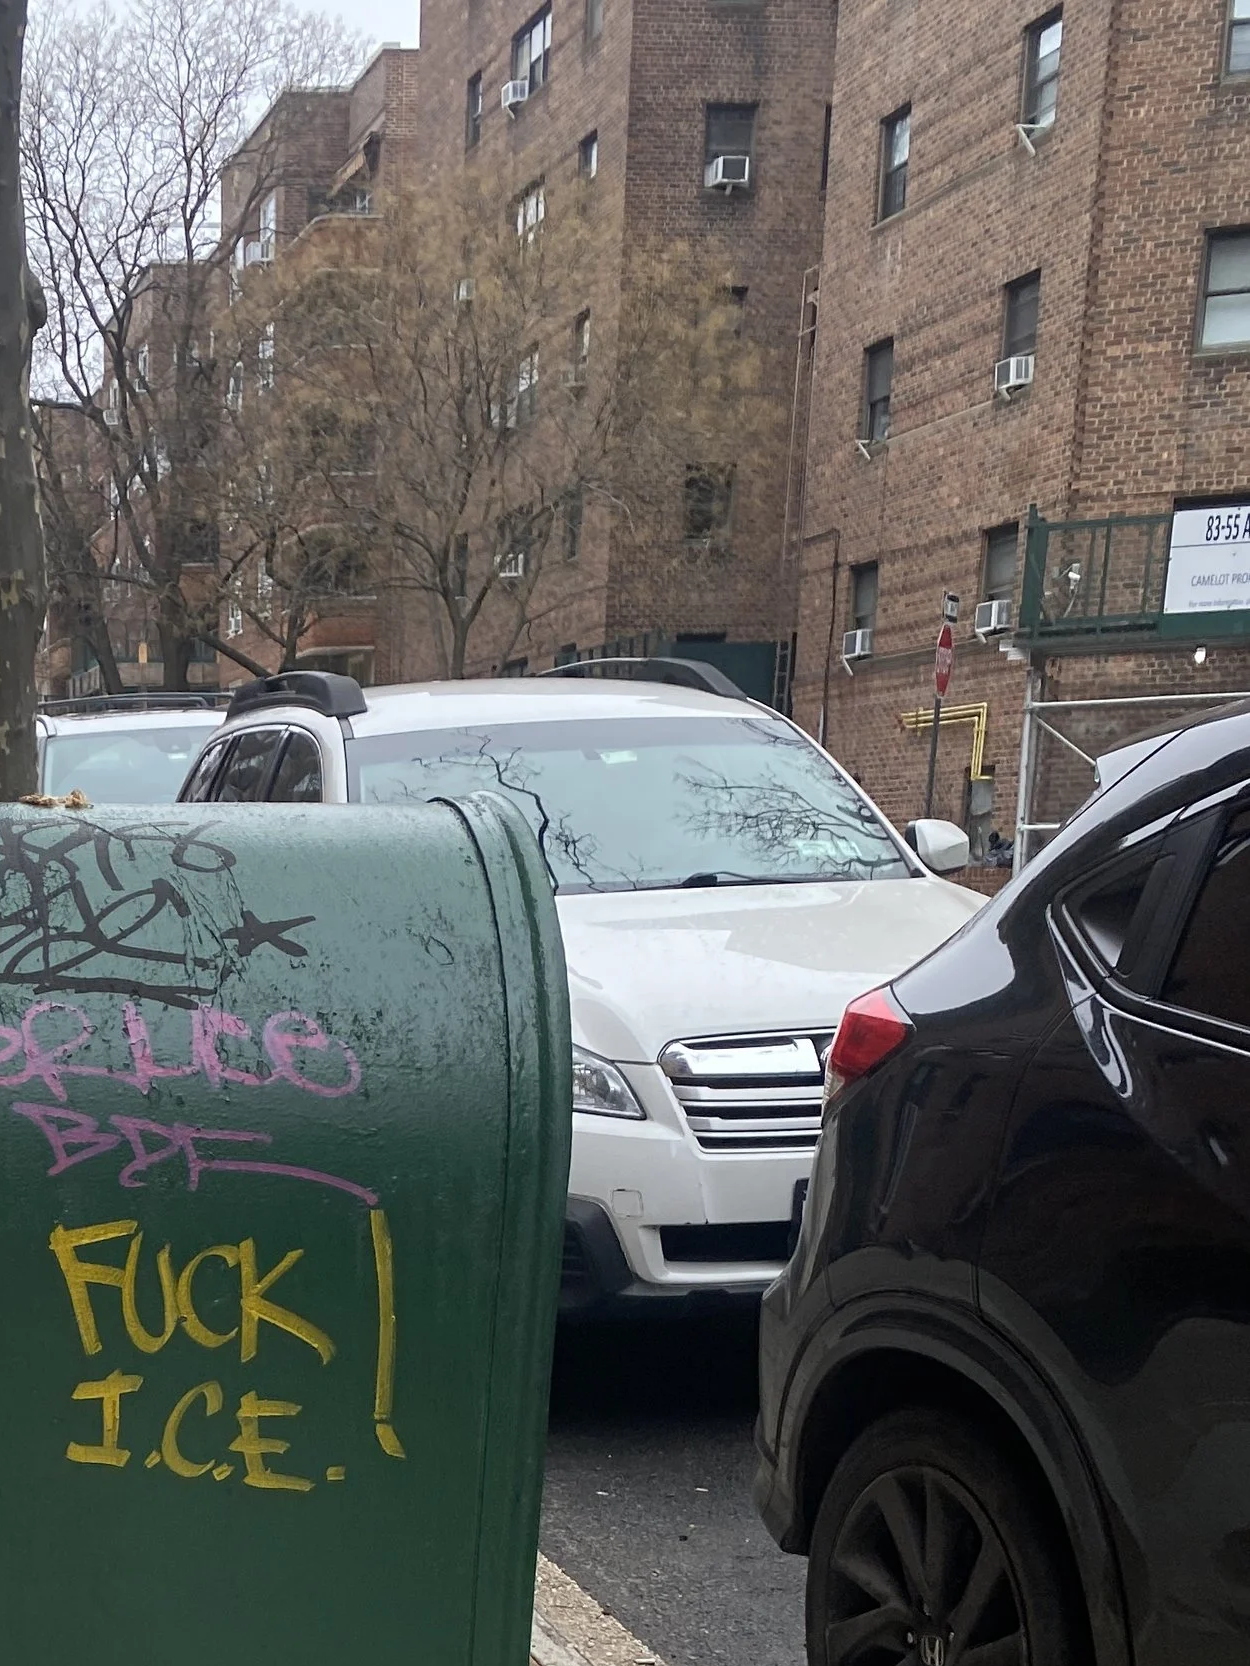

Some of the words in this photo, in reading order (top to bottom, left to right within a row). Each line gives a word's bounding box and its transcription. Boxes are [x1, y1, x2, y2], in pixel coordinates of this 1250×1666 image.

[1205, 513, 1241, 542] 83-55
[1190, 573, 1230, 587] CAMELOT
[49, 1218, 337, 1367] FUCK
